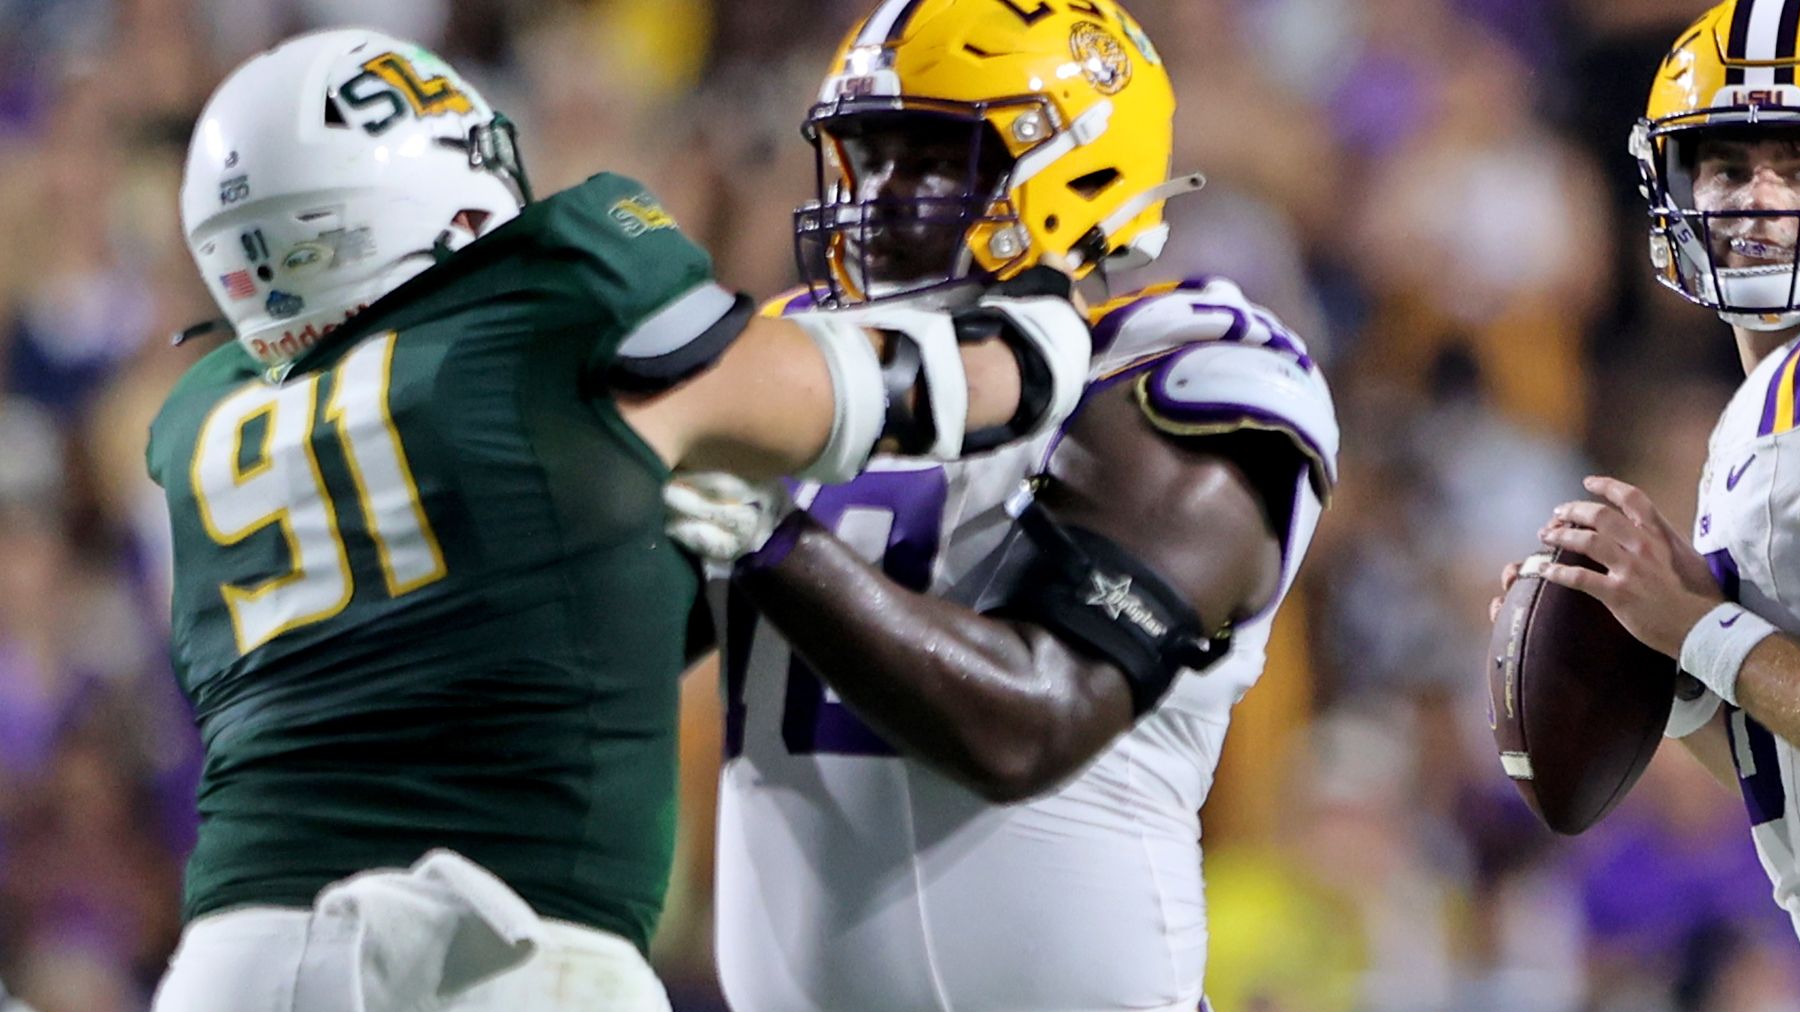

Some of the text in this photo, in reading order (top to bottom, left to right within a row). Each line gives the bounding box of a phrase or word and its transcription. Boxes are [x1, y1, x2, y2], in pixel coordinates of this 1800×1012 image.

[1733, 90, 1783, 108] LSU
[252, 303, 369, 359] Ridd
[189, 330, 448, 656] 91
